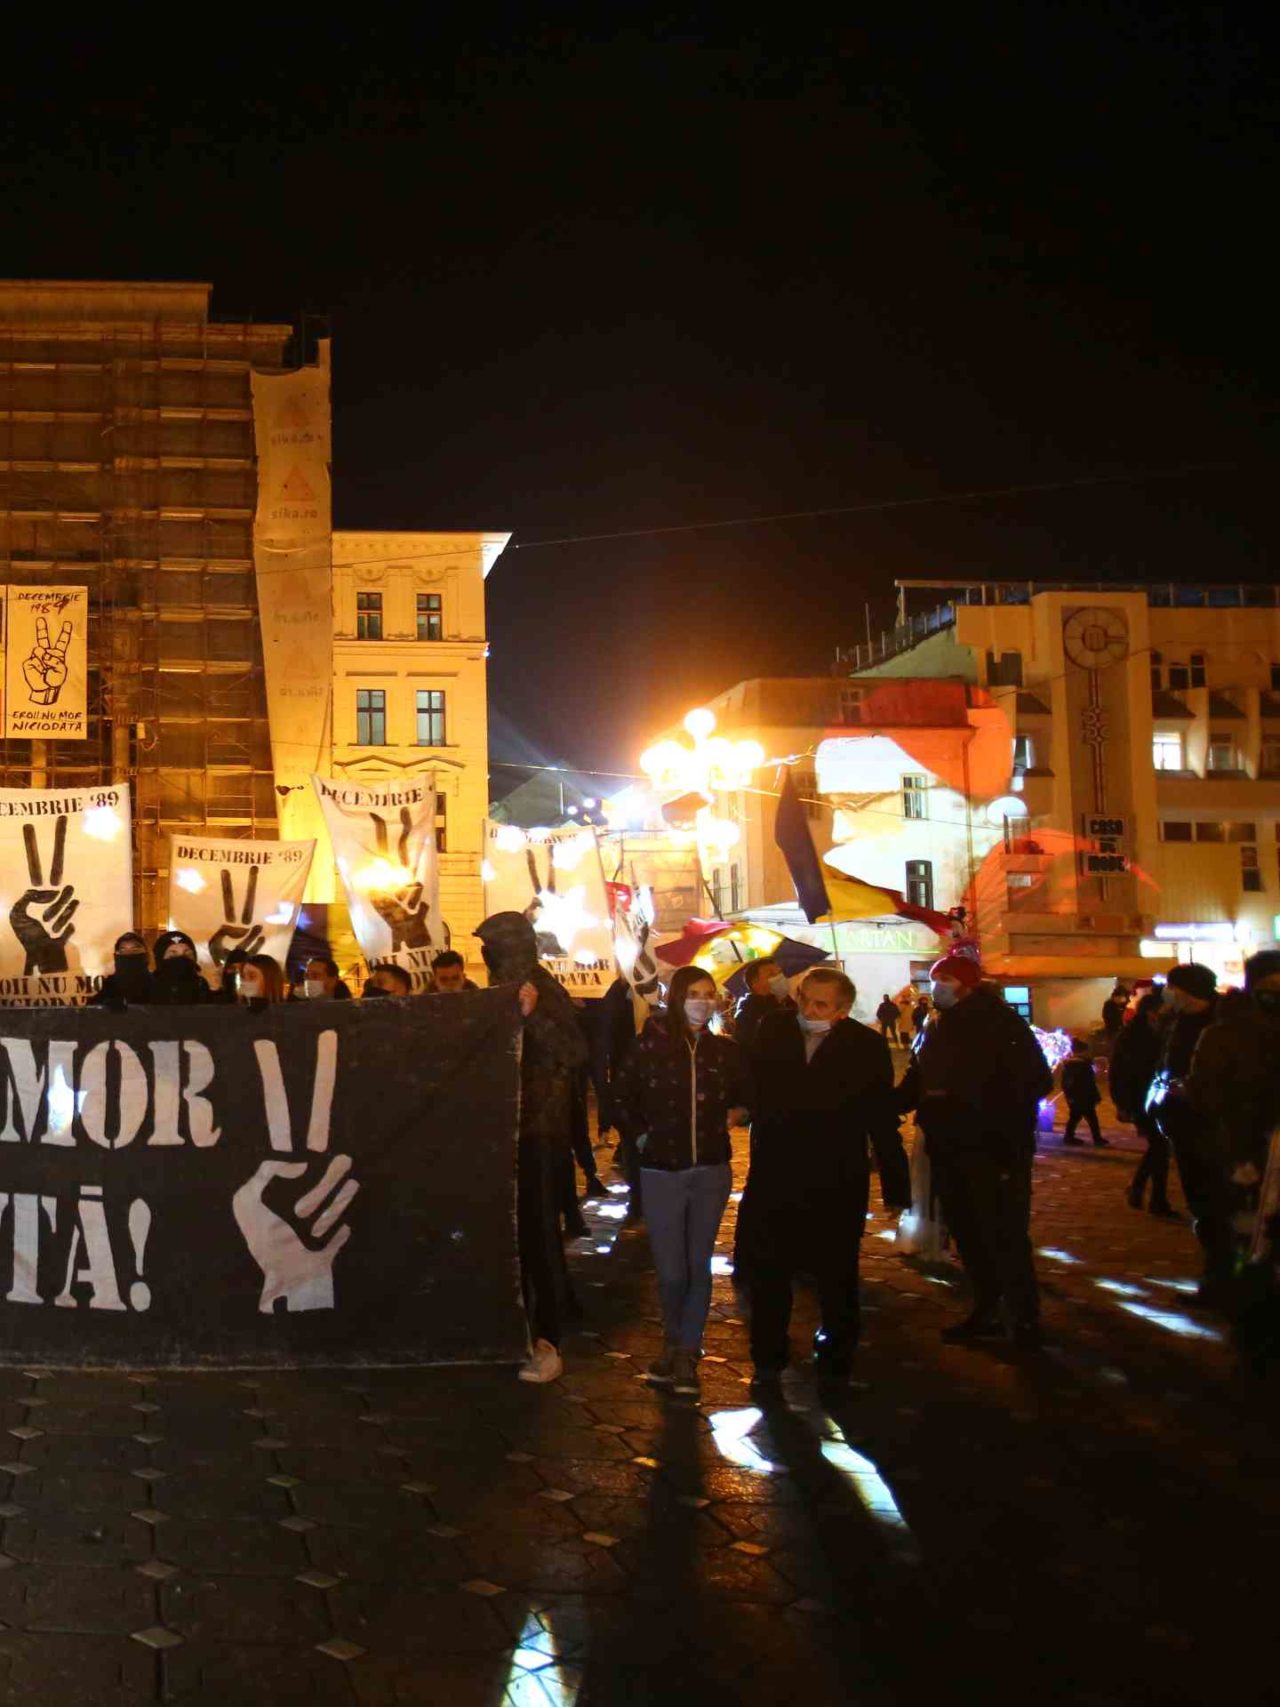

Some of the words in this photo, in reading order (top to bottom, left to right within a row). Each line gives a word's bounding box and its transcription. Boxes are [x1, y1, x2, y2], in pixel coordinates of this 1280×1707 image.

[90, 791, 119, 808] '89
[177, 846, 272, 865] DECEMBRIE
[278, 850, 303, 863] '89
[38, 976, 67, 995] NU
[76, 975, 104, 994] MO
[0, 1036, 221, 1150] MOR
